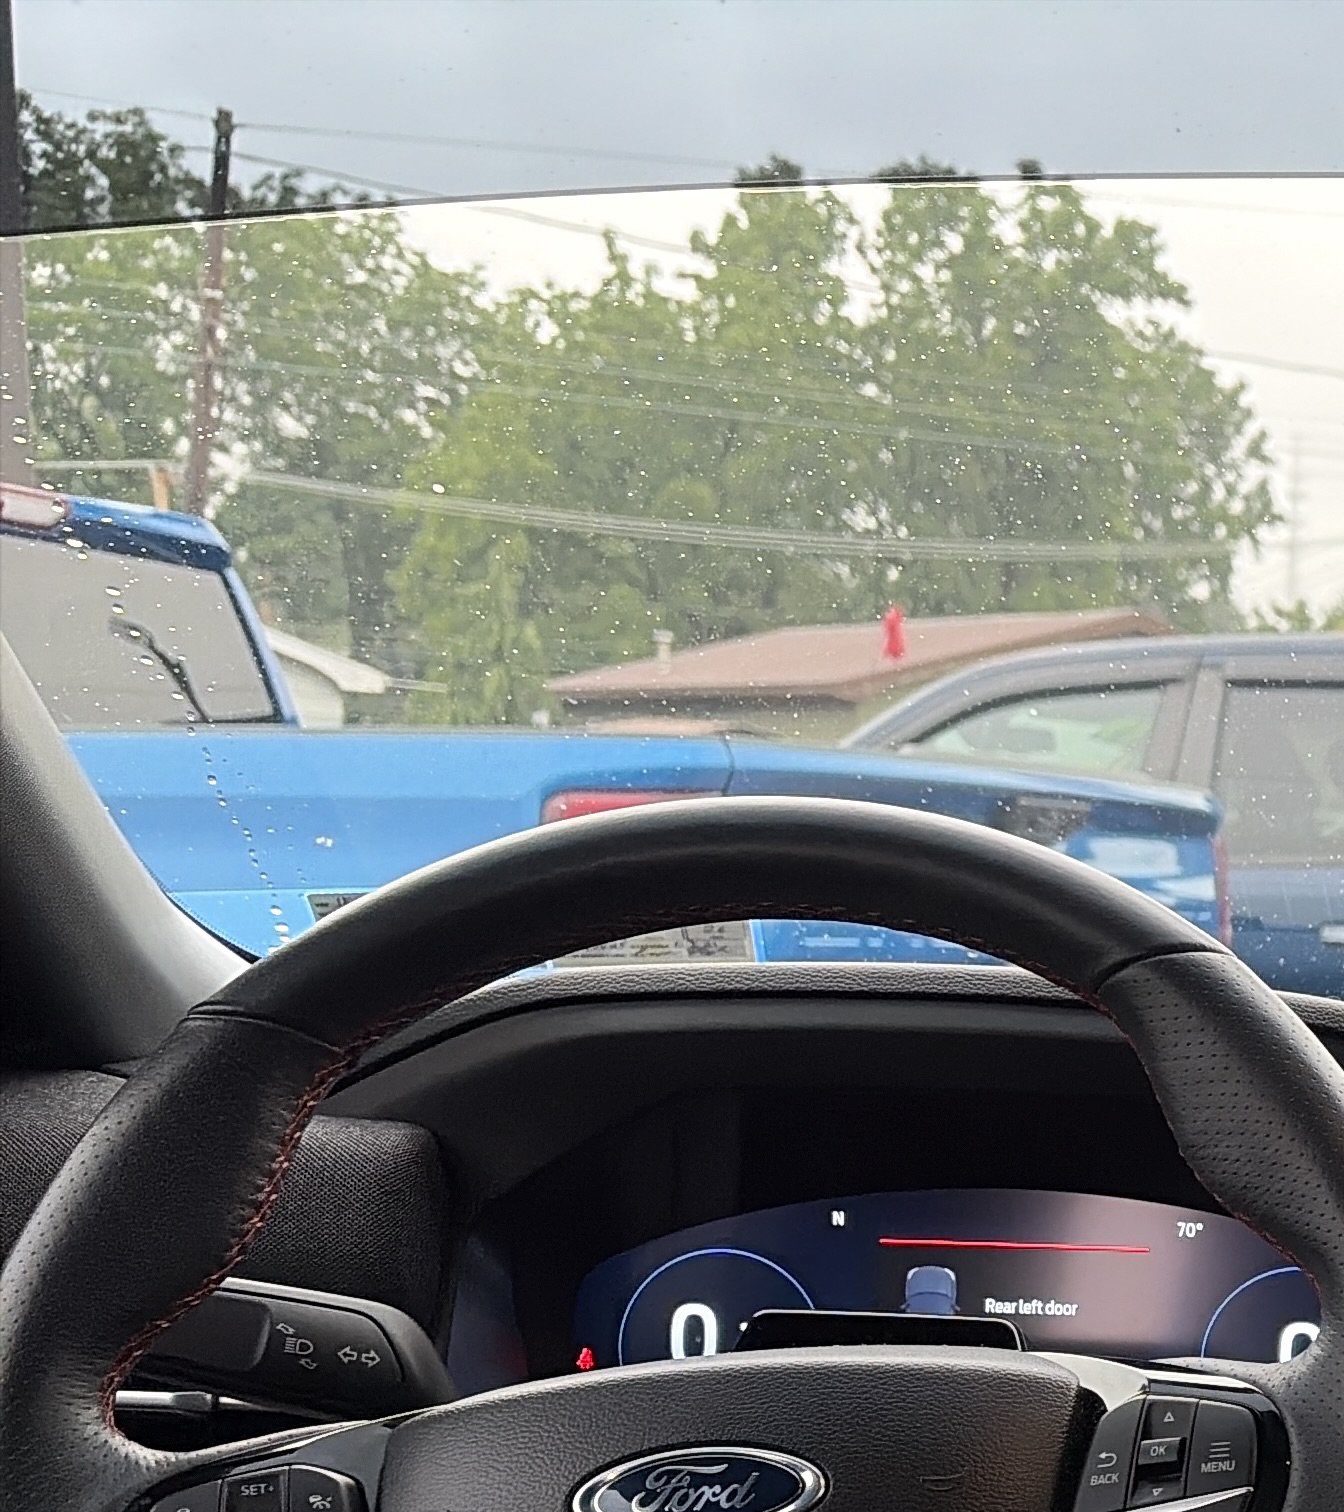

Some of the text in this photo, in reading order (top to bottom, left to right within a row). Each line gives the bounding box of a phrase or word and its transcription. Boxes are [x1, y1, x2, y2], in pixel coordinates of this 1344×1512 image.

[832, 1212, 845, 1226] N
[984, 1297, 1079, 1317] Rear left door
[670, 1302, 718, 1360] 0
[1150, 1445, 1166, 1457] OK
[1200, 1459, 1236, 1473] MENU
[1090, 1472, 1120, 1486] BACK
